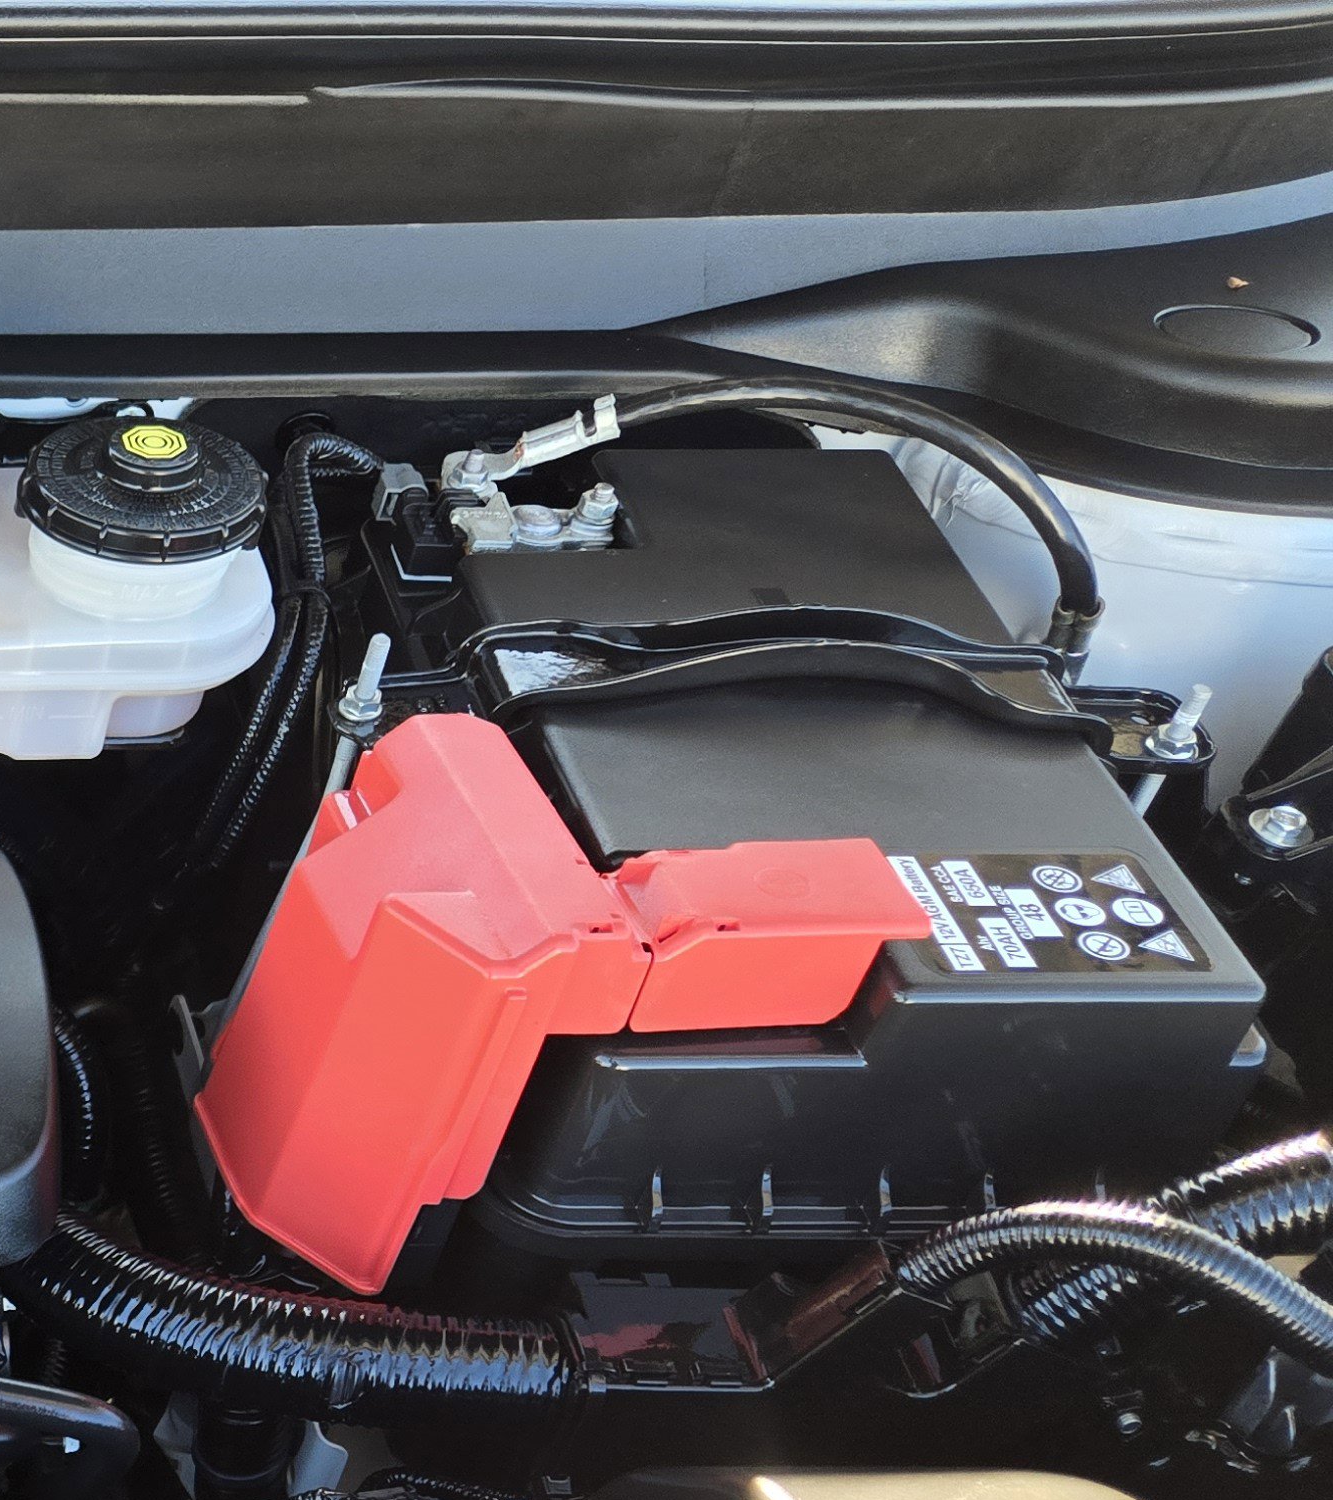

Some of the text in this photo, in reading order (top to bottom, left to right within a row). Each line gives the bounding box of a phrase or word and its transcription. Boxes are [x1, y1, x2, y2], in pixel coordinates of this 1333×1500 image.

[942, 884, 963, 902] SAE
[954, 868, 985, 898] 650A
[898, 859, 974, 968] TZ7 12V AGM Battery
[988, 885, 1033, 938] GROUP SIZE
[1019, 903, 1044, 921] 48
[990, 926, 1025, 960] 70AH
